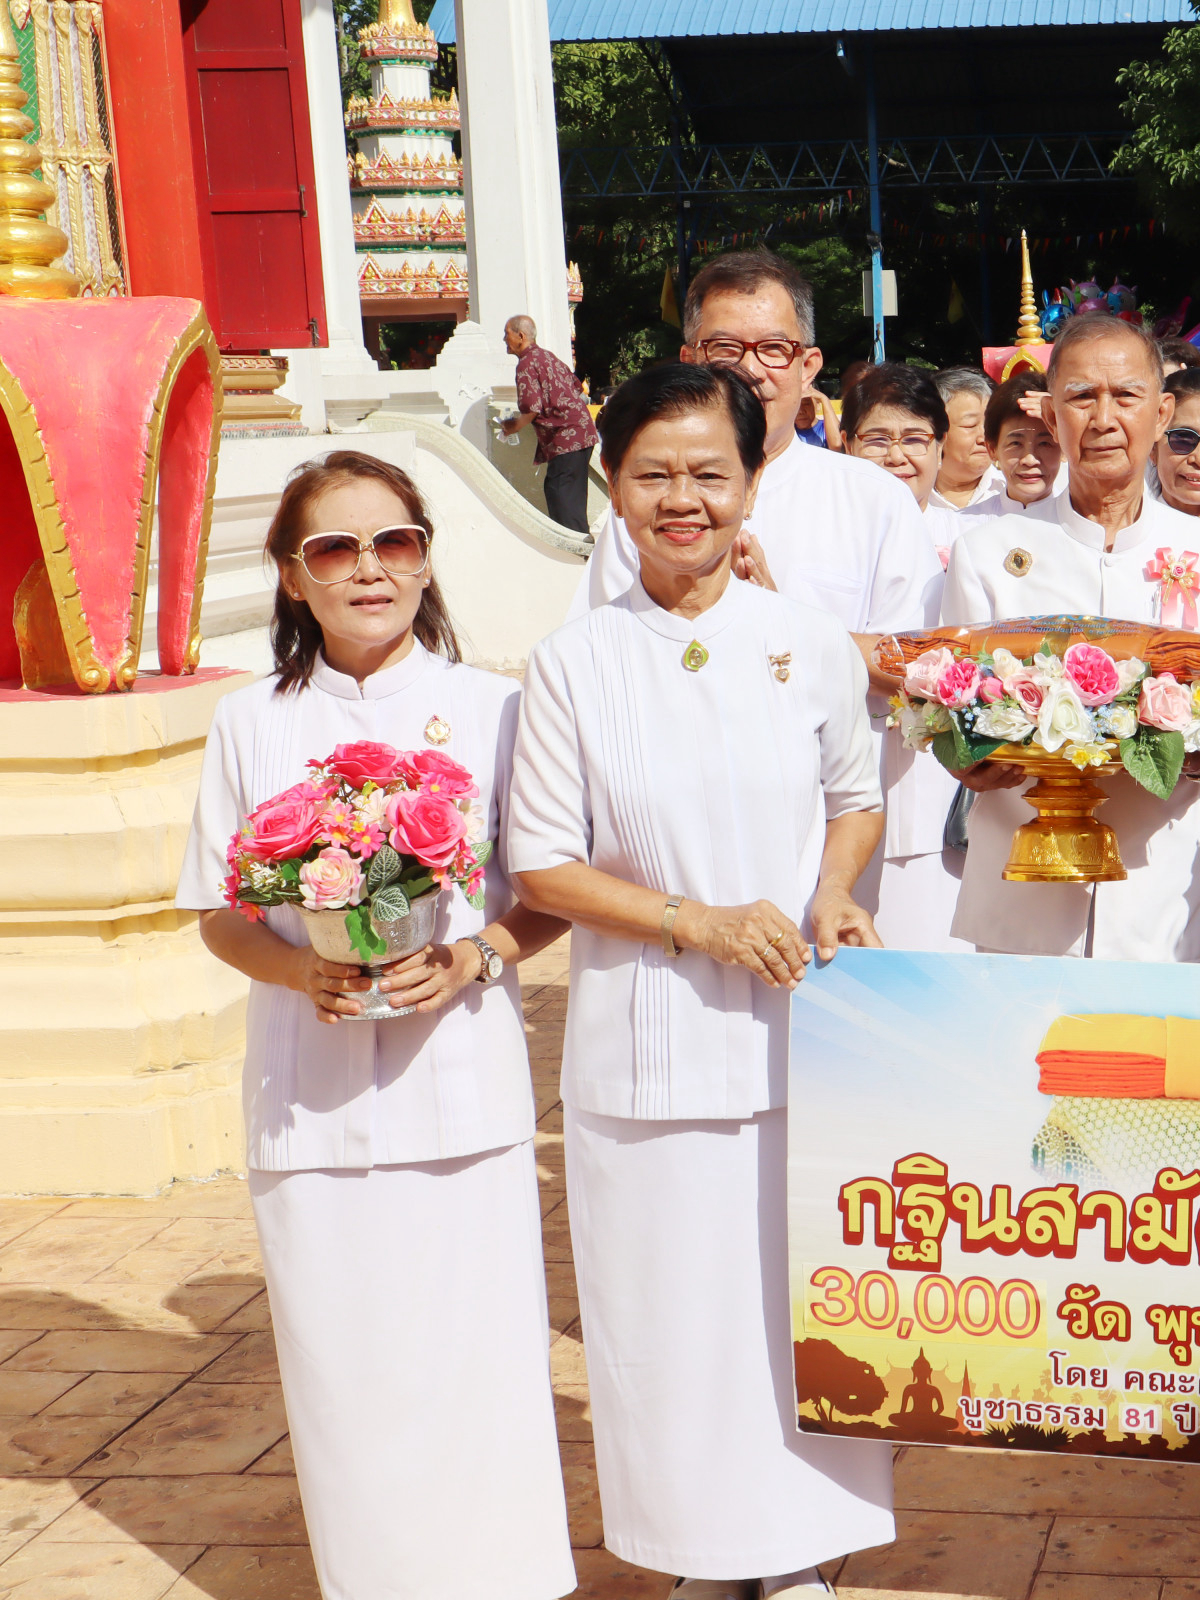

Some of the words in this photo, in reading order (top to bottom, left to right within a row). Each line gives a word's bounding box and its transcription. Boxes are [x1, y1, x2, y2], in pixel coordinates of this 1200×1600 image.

[810, 1266, 1040, 1339] 30,000
[1056, 1282, 1131, 1342] วัด
[1049, 1351, 1108, 1388] โดย
[960, 1397, 1103, 1429] บูชาธรรม
[1125, 1408, 1155, 1429] 81
[1173, 1402, 1196, 1434] ปี
